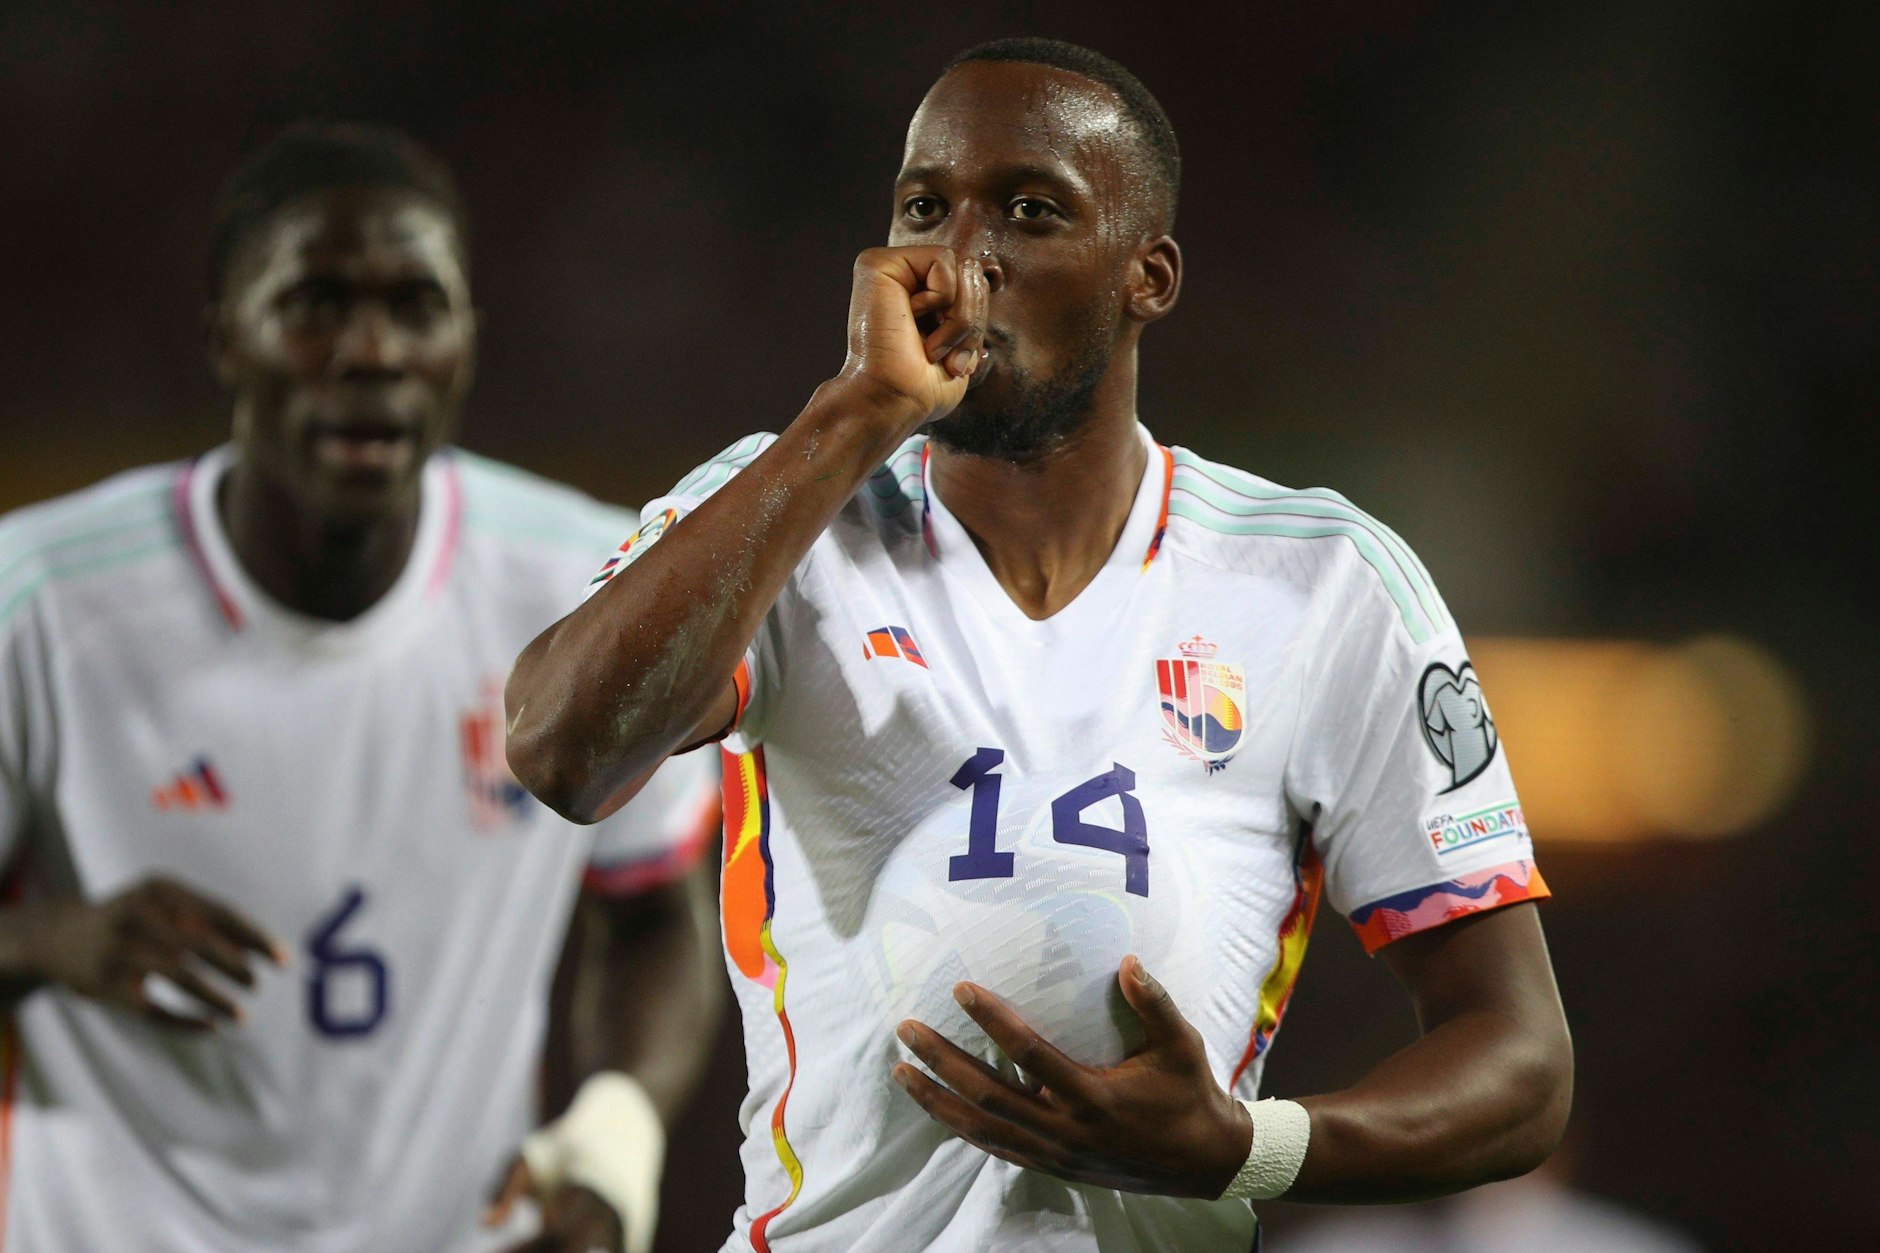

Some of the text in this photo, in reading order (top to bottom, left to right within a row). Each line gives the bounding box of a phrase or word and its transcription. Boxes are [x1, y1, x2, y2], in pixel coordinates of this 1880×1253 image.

[949, 747, 1150, 898] 14
[1426, 814, 1454, 830] UEFA
[307, 884, 389, 1037] 6
